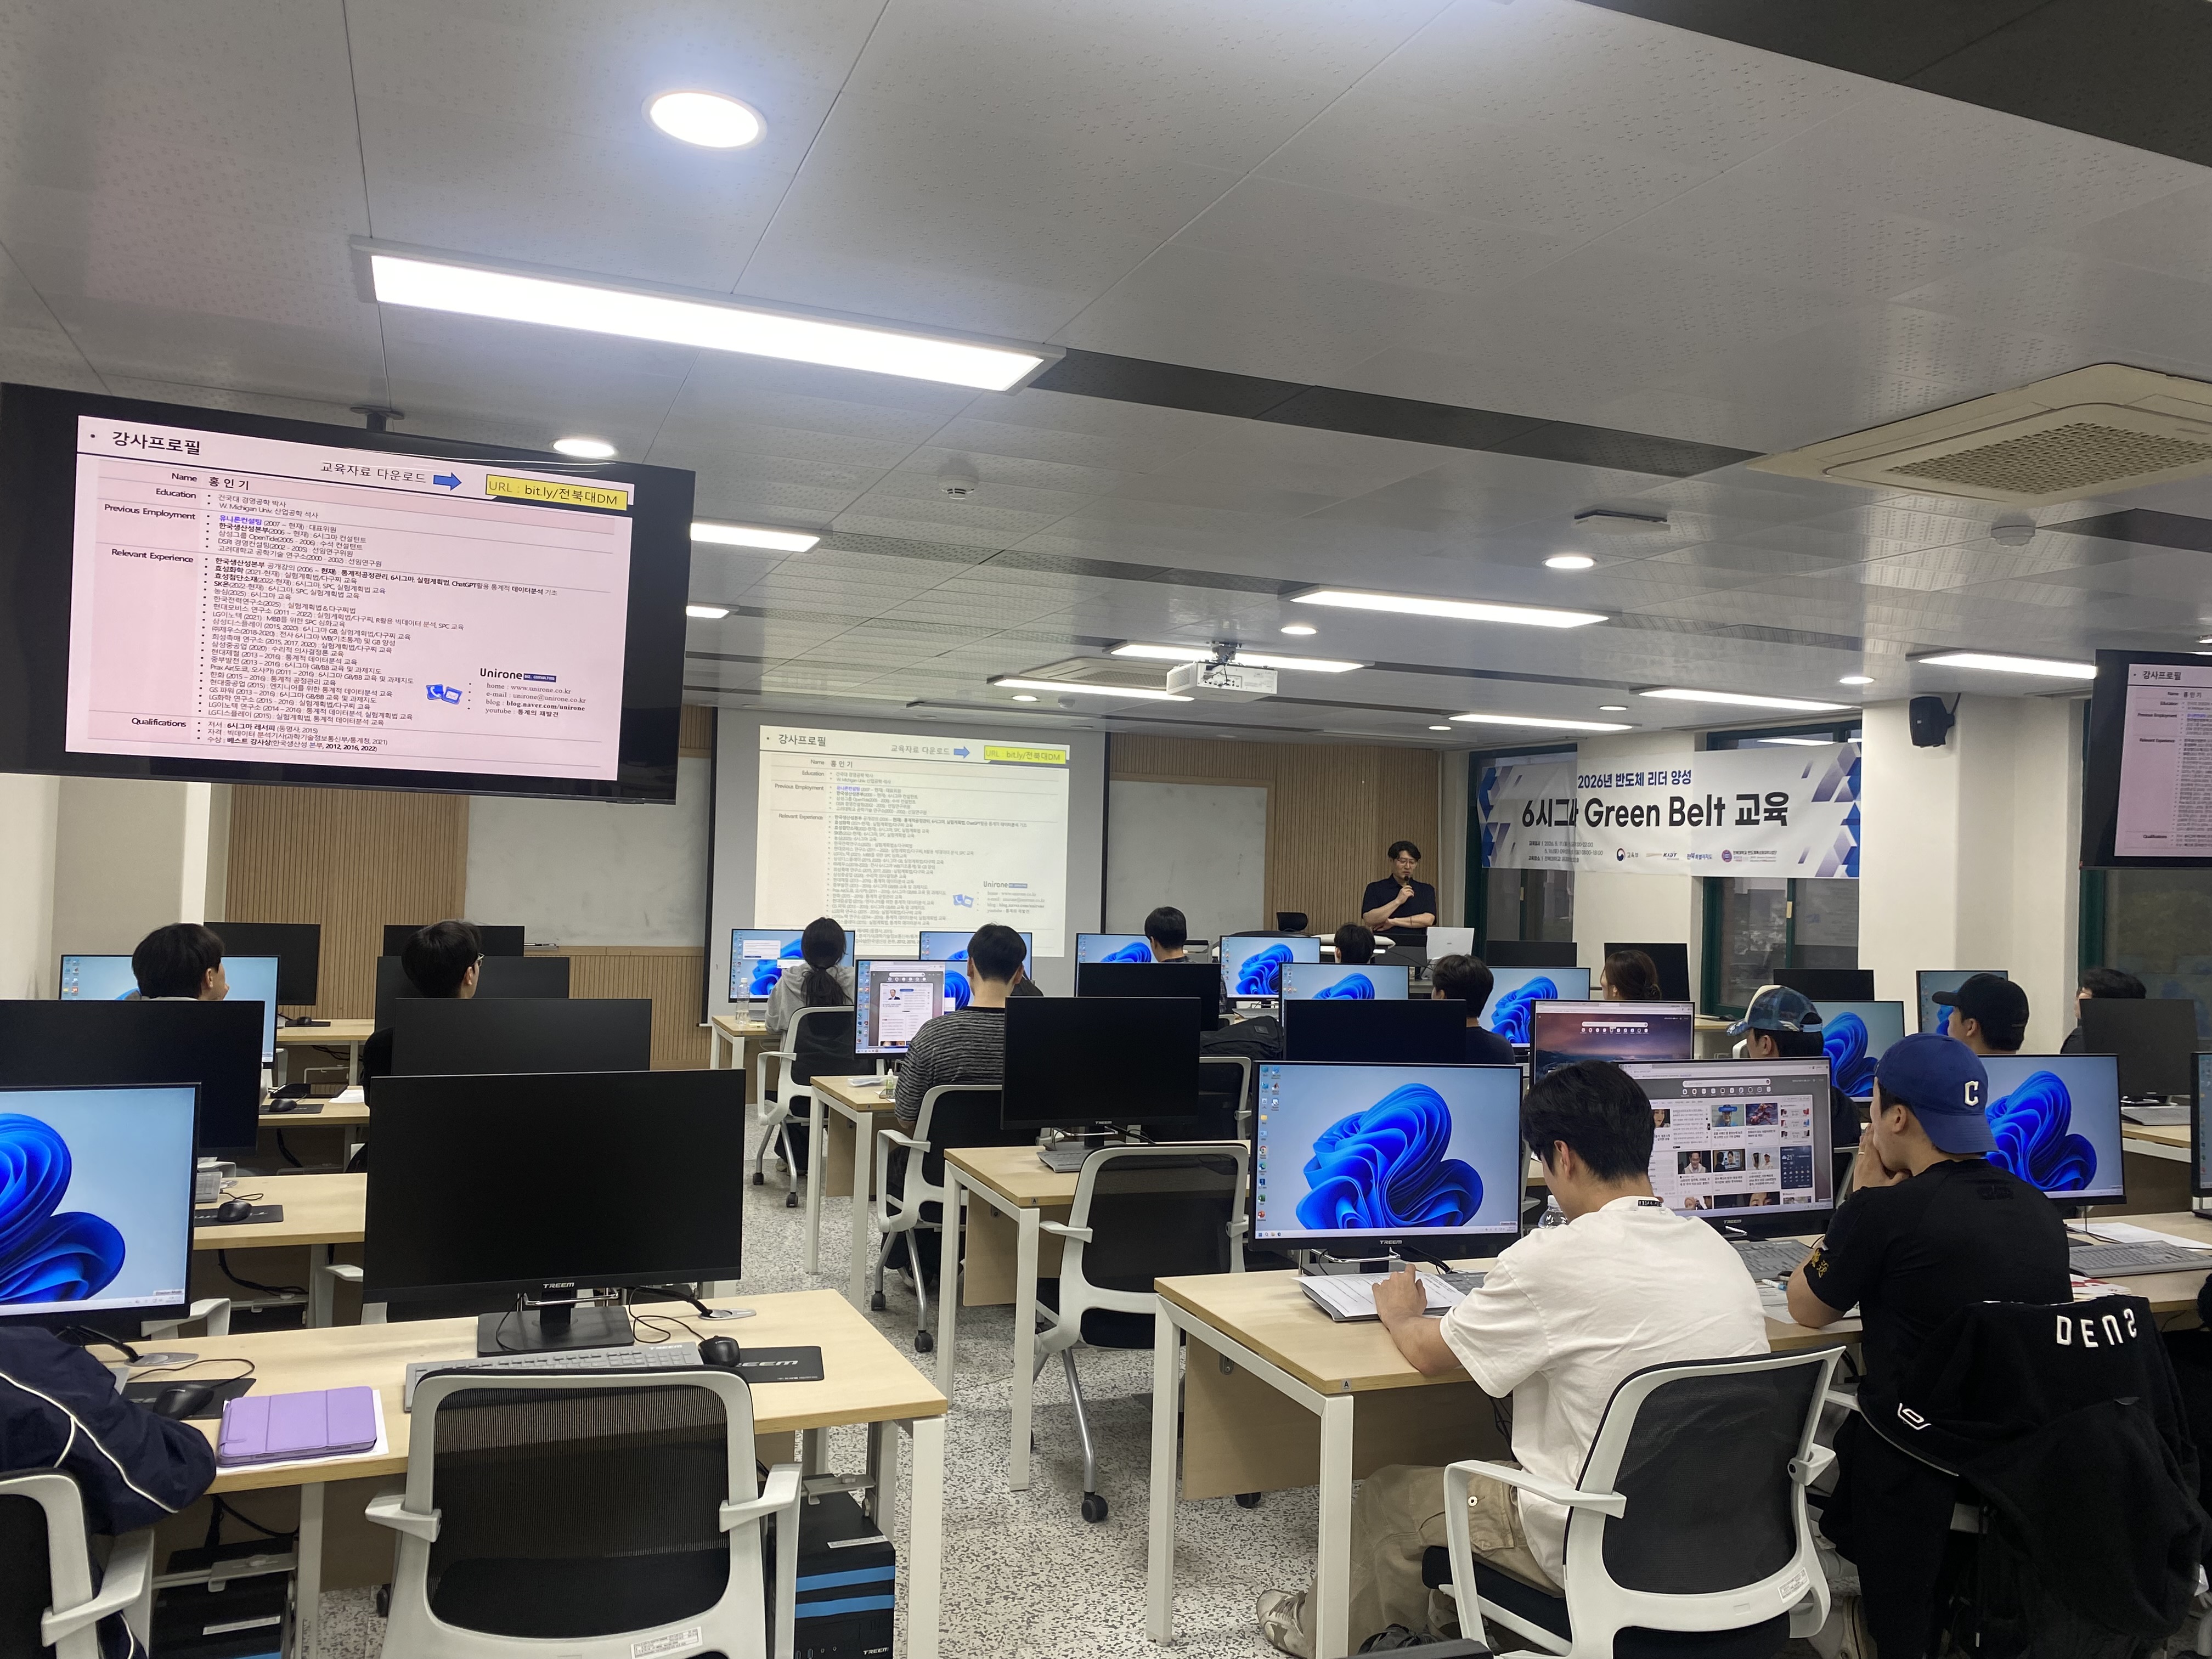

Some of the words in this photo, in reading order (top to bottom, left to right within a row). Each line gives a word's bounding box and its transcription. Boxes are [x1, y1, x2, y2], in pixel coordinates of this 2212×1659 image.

[112, 431, 200, 455] 강사프로필
[172, 472, 197, 482] Name
[320, 461, 371, 478] 교육자료
[377, 468, 426, 484] 다운로드
[208, 476, 220, 487] 홍
[223, 478, 234, 488] 인
[238, 479, 249, 490] 기
[156, 488, 196, 499] Education
[489, 481, 512, 493] URL
[525, 485, 617, 505] bit.ly/전북대DM
[104, 503, 140, 514] Previous
[143, 507, 195, 521] Employment
[229, 504, 257, 512] Michigan
[111, 548, 147, 558] Relevant
[150, 552, 194, 564] Experience
[479, 667, 522, 680] Unirone
[2143, 671, 2181, 680] 강사프로필
[131, 717, 187, 727] Qualifications
[778, 733, 826, 747] 강사프로필
[890, 744, 919, 754] 교육자료
[922, 746, 950, 756] 다운로드
[1578, 774, 1612, 789] 2026년
[1616, 772, 1644, 787] 반도체
[1648, 771, 1667, 787] 리더
[1672, 770, 1691, 785] 양성
[1585, 798, 1660, 828] Green
[1668, 794, 1725, 827] Belt
[1735, 792, 1788, 826] 교육
[1965, 1081, 1979, 1107] C
[863, 1646, 889, 1656] TREEM
